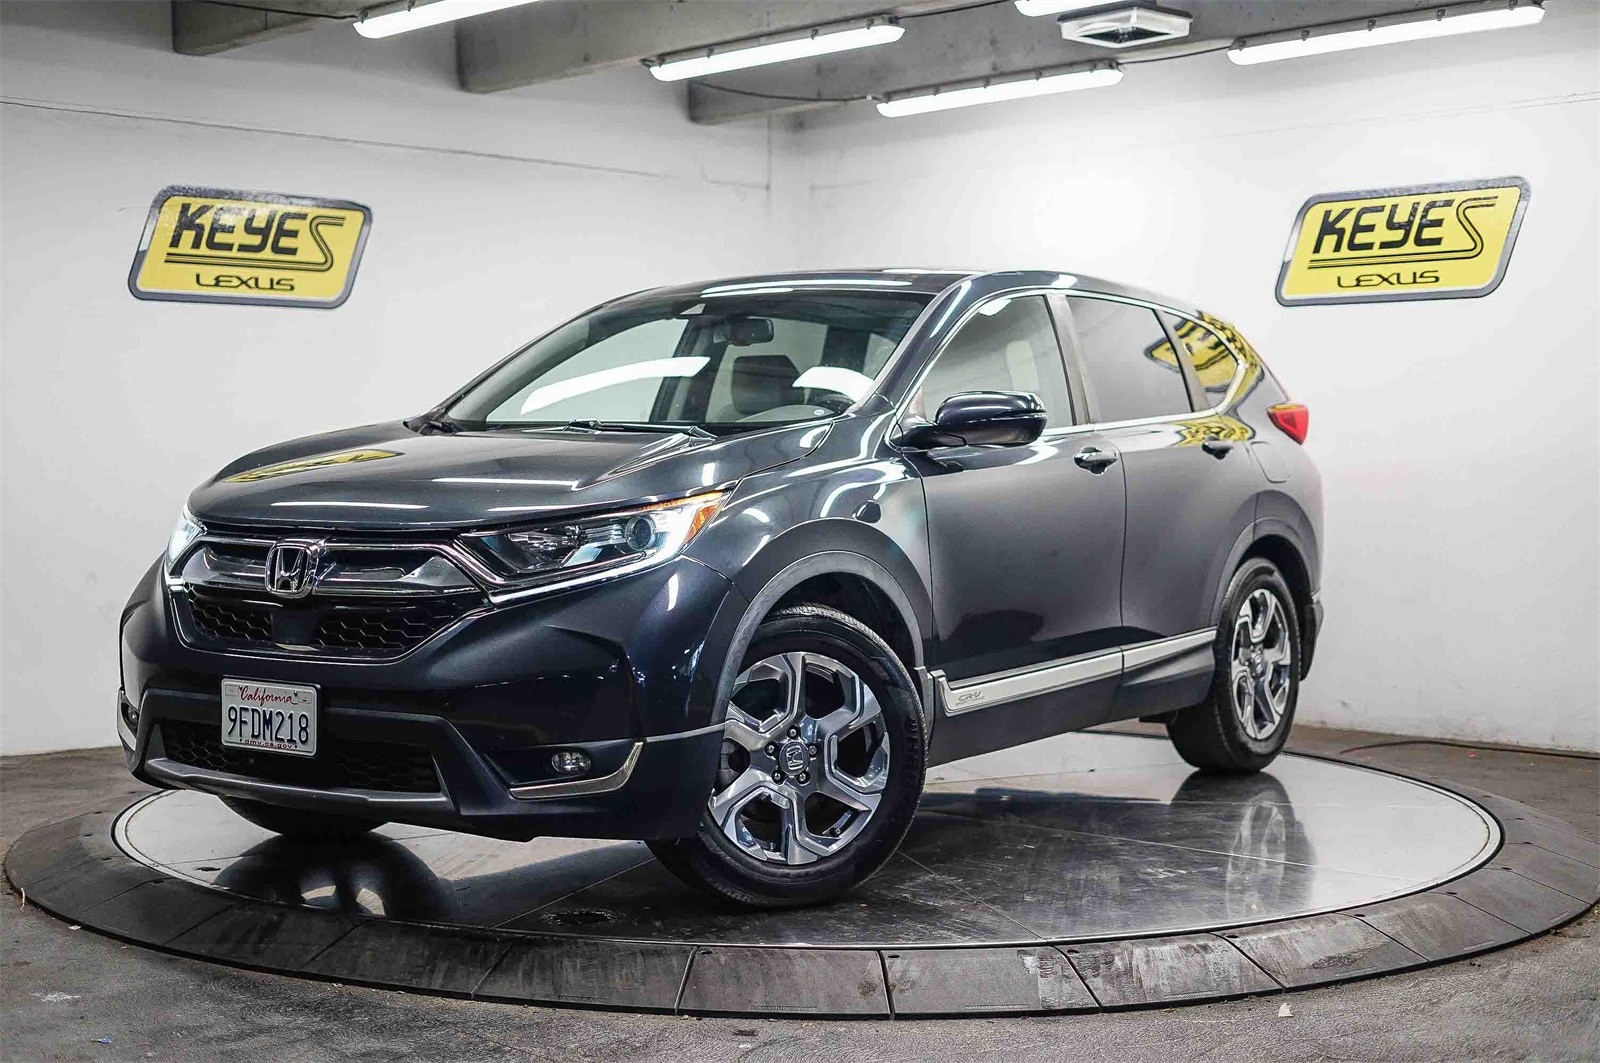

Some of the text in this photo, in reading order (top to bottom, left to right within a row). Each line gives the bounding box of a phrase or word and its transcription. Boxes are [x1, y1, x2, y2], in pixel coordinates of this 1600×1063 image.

[168, 203, 345, 272] KEYES
[1312, 196, 1499, 259] KEYES
[195, 272, 296, 292] LEXUS
[1336, 269, 1440, 289] LEXUS
[240, 685, 299, 707] California
[227, 705, 310, 745] 9FDM218
[244, 738, 293, 750] dmv.ca.gov
